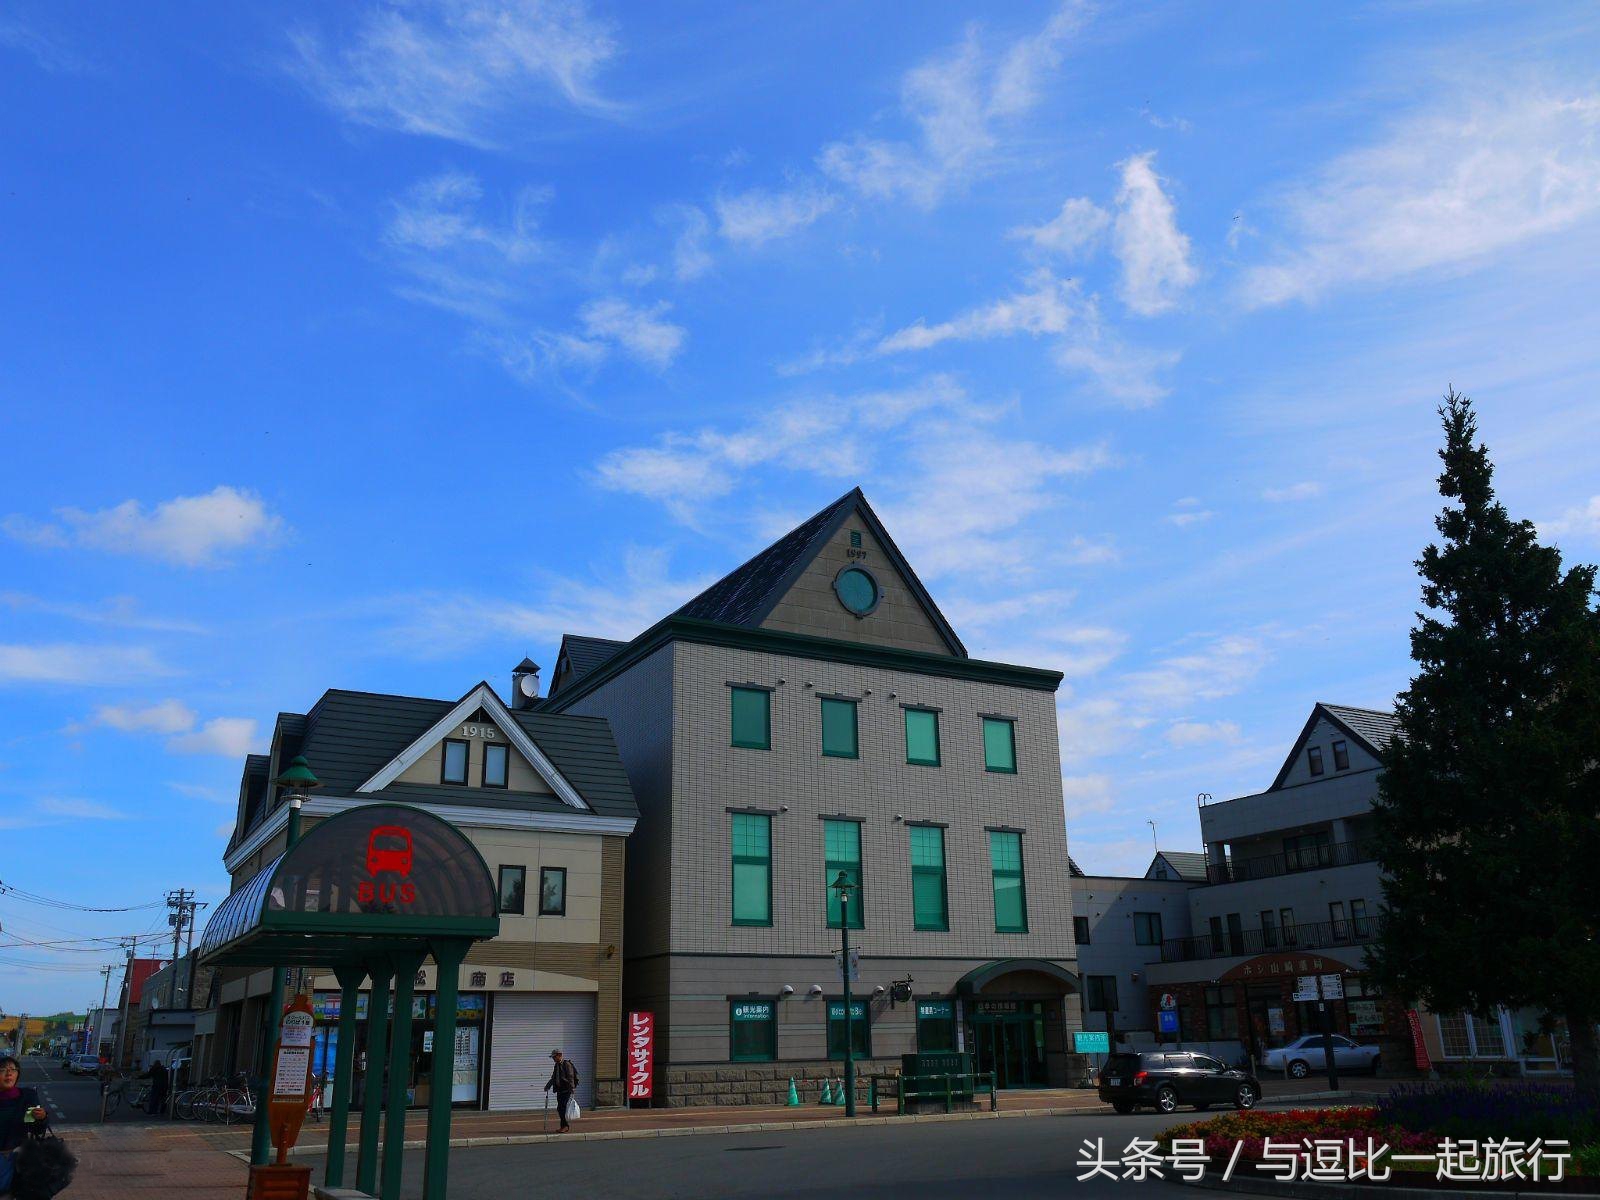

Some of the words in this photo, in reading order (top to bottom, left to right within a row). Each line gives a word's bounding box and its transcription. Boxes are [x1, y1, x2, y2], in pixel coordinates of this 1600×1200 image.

[462, 726, 495, 739] 1915
[358, 880, 416, 904] BUS
[630, 1013, 650, 1097] レンタサイクル
